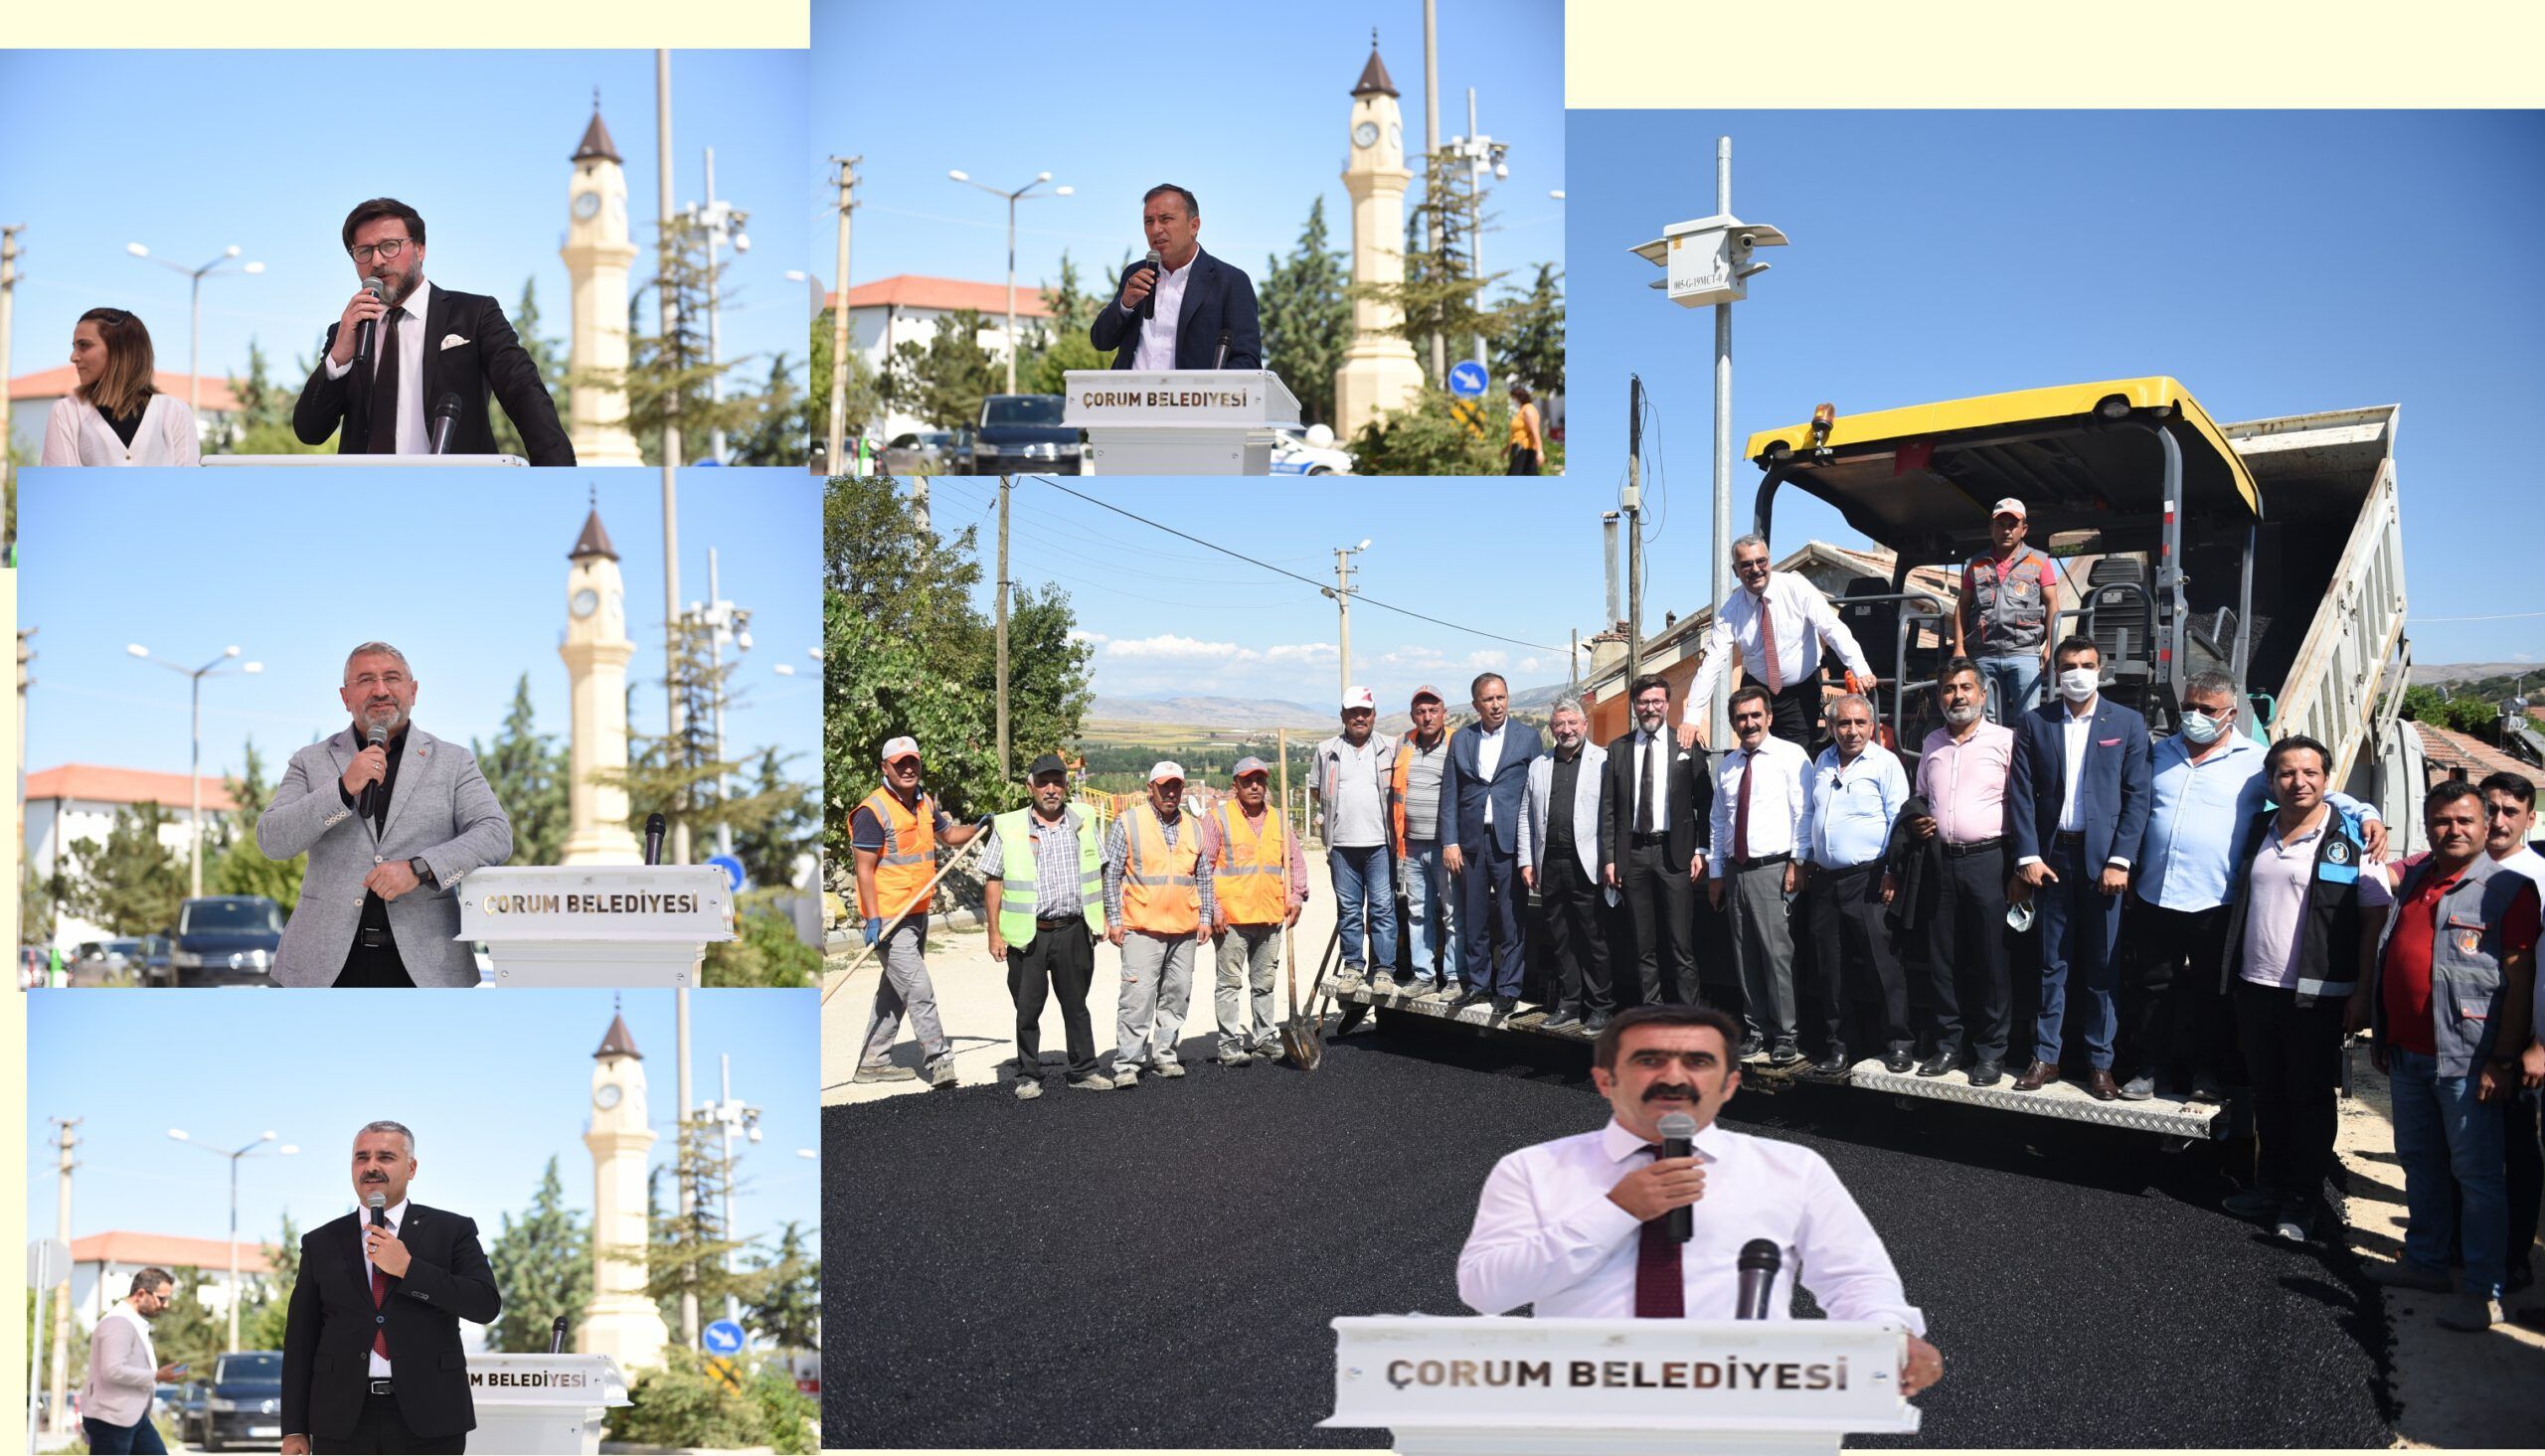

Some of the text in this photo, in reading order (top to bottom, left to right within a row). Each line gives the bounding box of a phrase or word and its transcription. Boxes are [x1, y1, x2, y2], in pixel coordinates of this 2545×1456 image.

[1083, 388, 1247, 408] ÇORUM BELEDİYESİ
[482, 890, 698, 916] ÇORUM BELEDİYESİ
[488, 1371, 587, 1387] BELEDİYESİ
[1387, 1355, 1848, 1390] ÇORUM BELEDİYESİ
